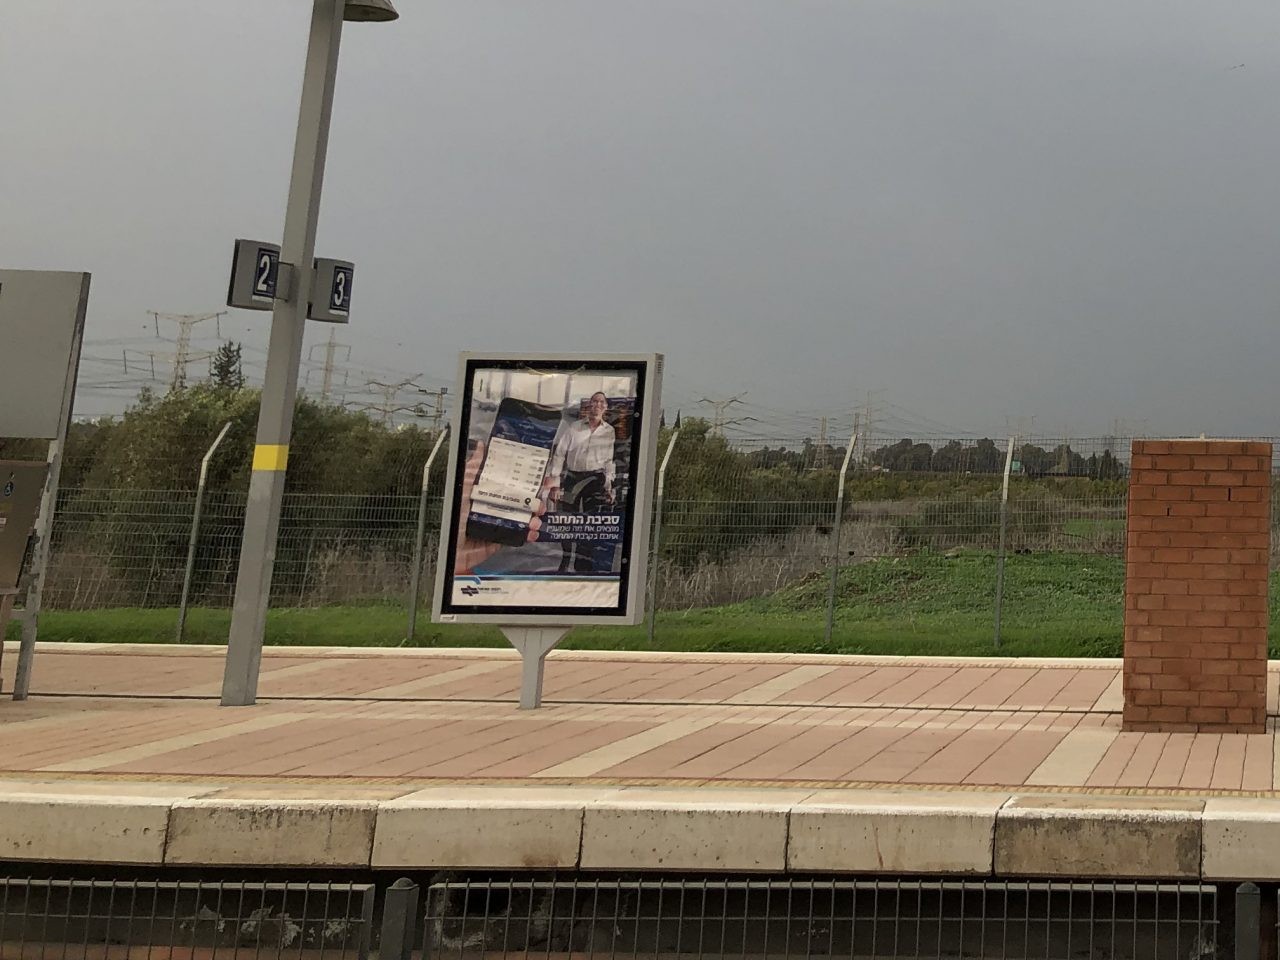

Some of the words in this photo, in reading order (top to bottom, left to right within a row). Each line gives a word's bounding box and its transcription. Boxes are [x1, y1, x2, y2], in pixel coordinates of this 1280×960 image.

[257, 255, 271, 291] 2
[334, 271, 345, 306] 3
[547, 515, 584, 525] התחנה
[586, 515, 620, 525] סביבת
